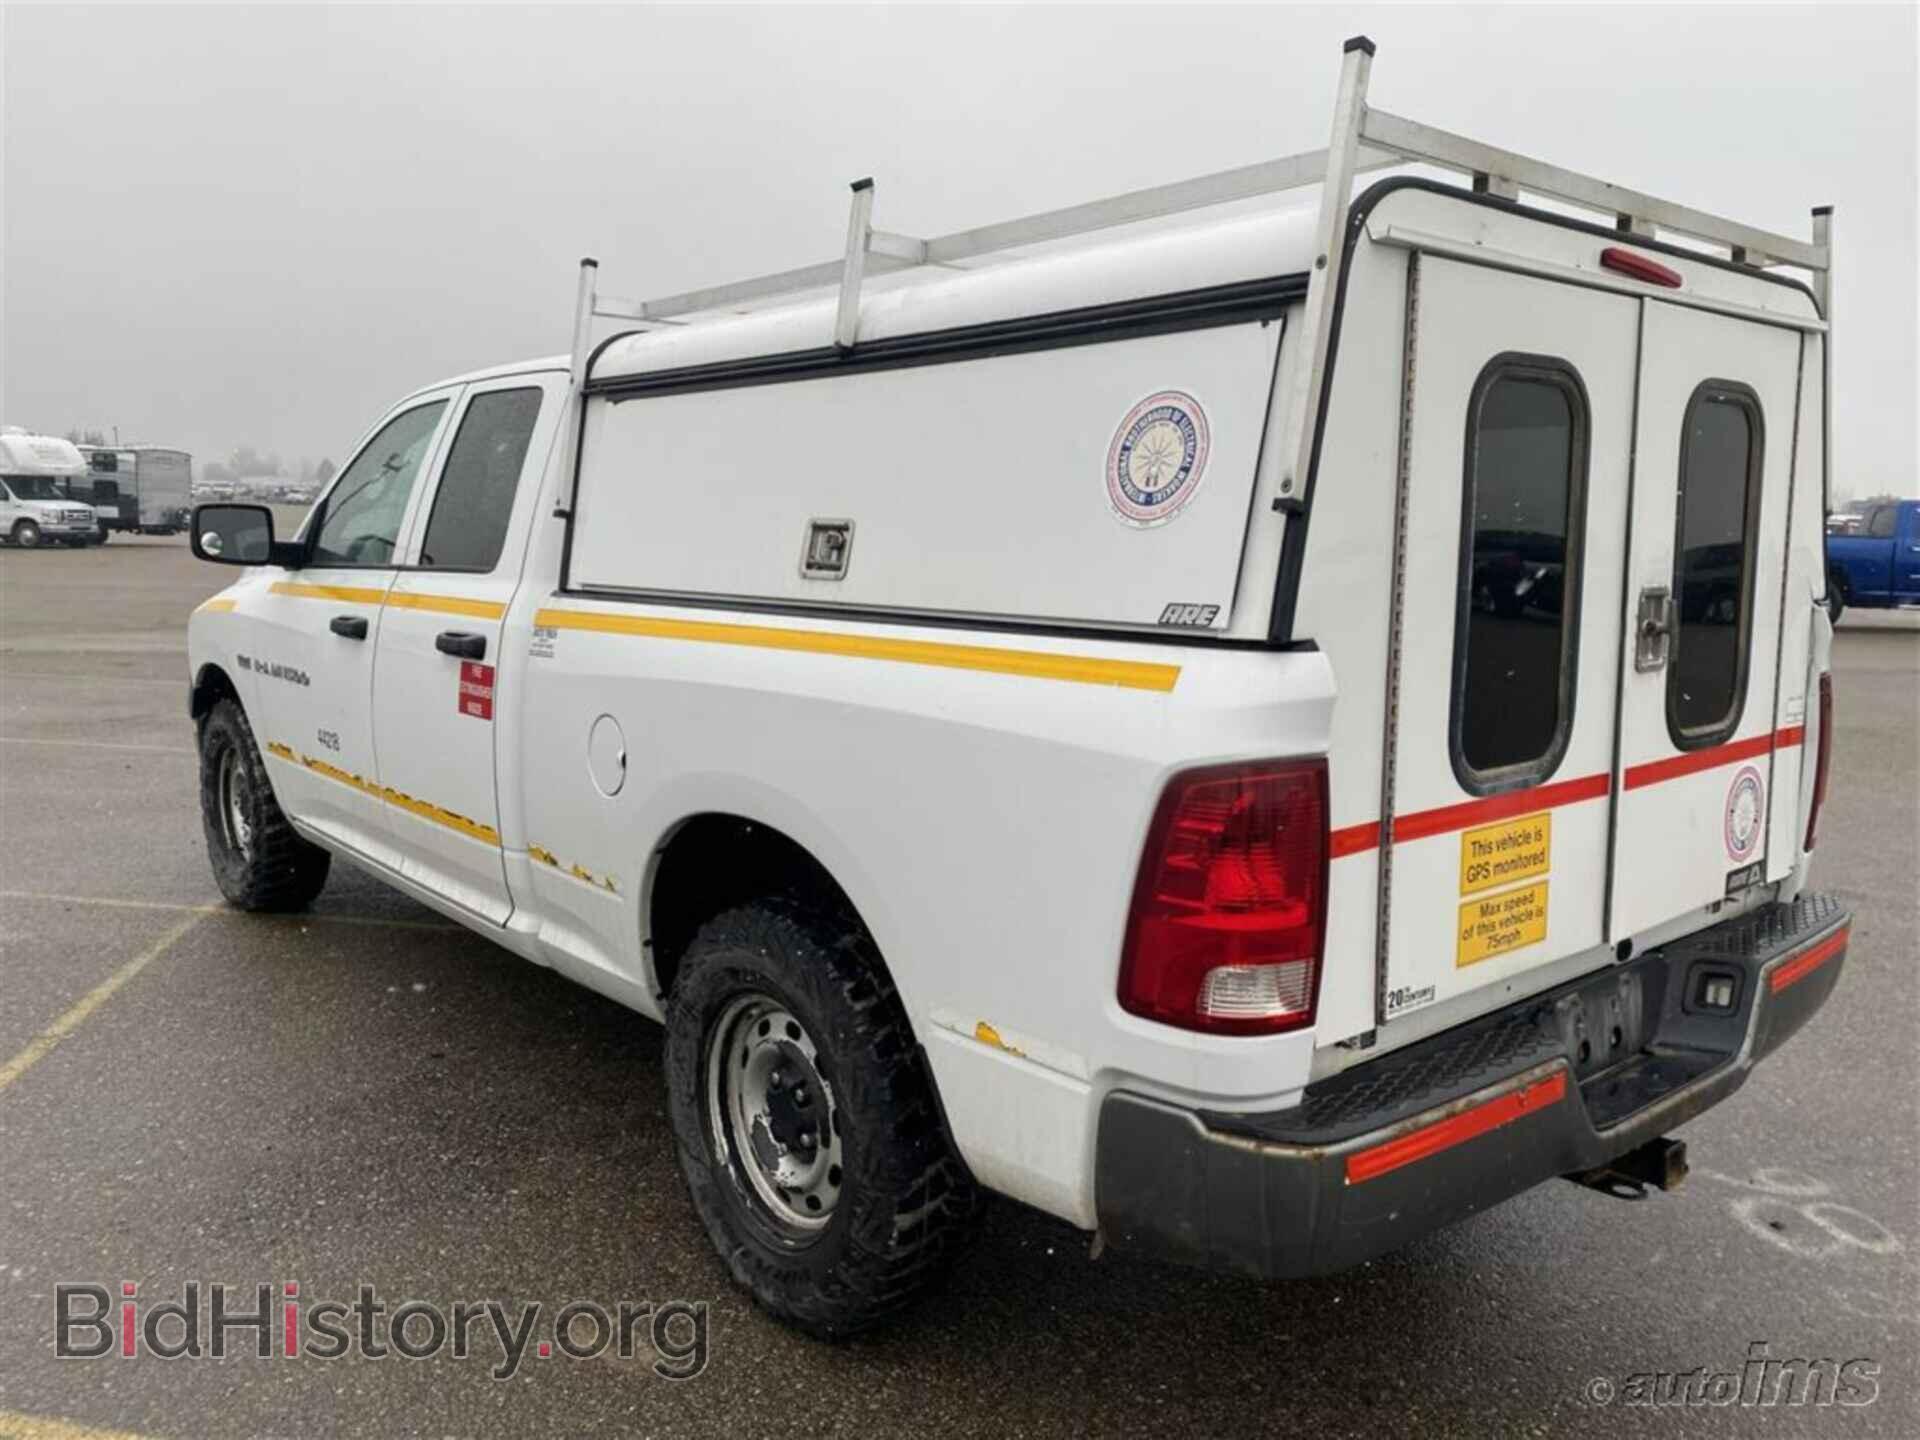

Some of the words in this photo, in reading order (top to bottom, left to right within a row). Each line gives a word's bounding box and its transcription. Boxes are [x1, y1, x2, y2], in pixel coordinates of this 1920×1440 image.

[1159, 602, 1220, 626] ARE
[1471, 839, 1493, 858] This
[1495, 832, 1532, 853] vehicle
[1533, 828, 1543, 842] is
[1466, 862, 1490, 883] GPS
[1493, 849, 1545, 875] monitored
[1480, 902, 1501, 918] Max
[1503, 890, 1536, 914] speed
[1462, 925, 1474, 941] of
[1476, 918, 1496, 936] this
[1499, 909, 1534, 930] vehicle
[1535, 905, 1544, 919] is
[1487, 929, 1521, 950] 75mph
[1388, 989, 1403, 1008] 20
